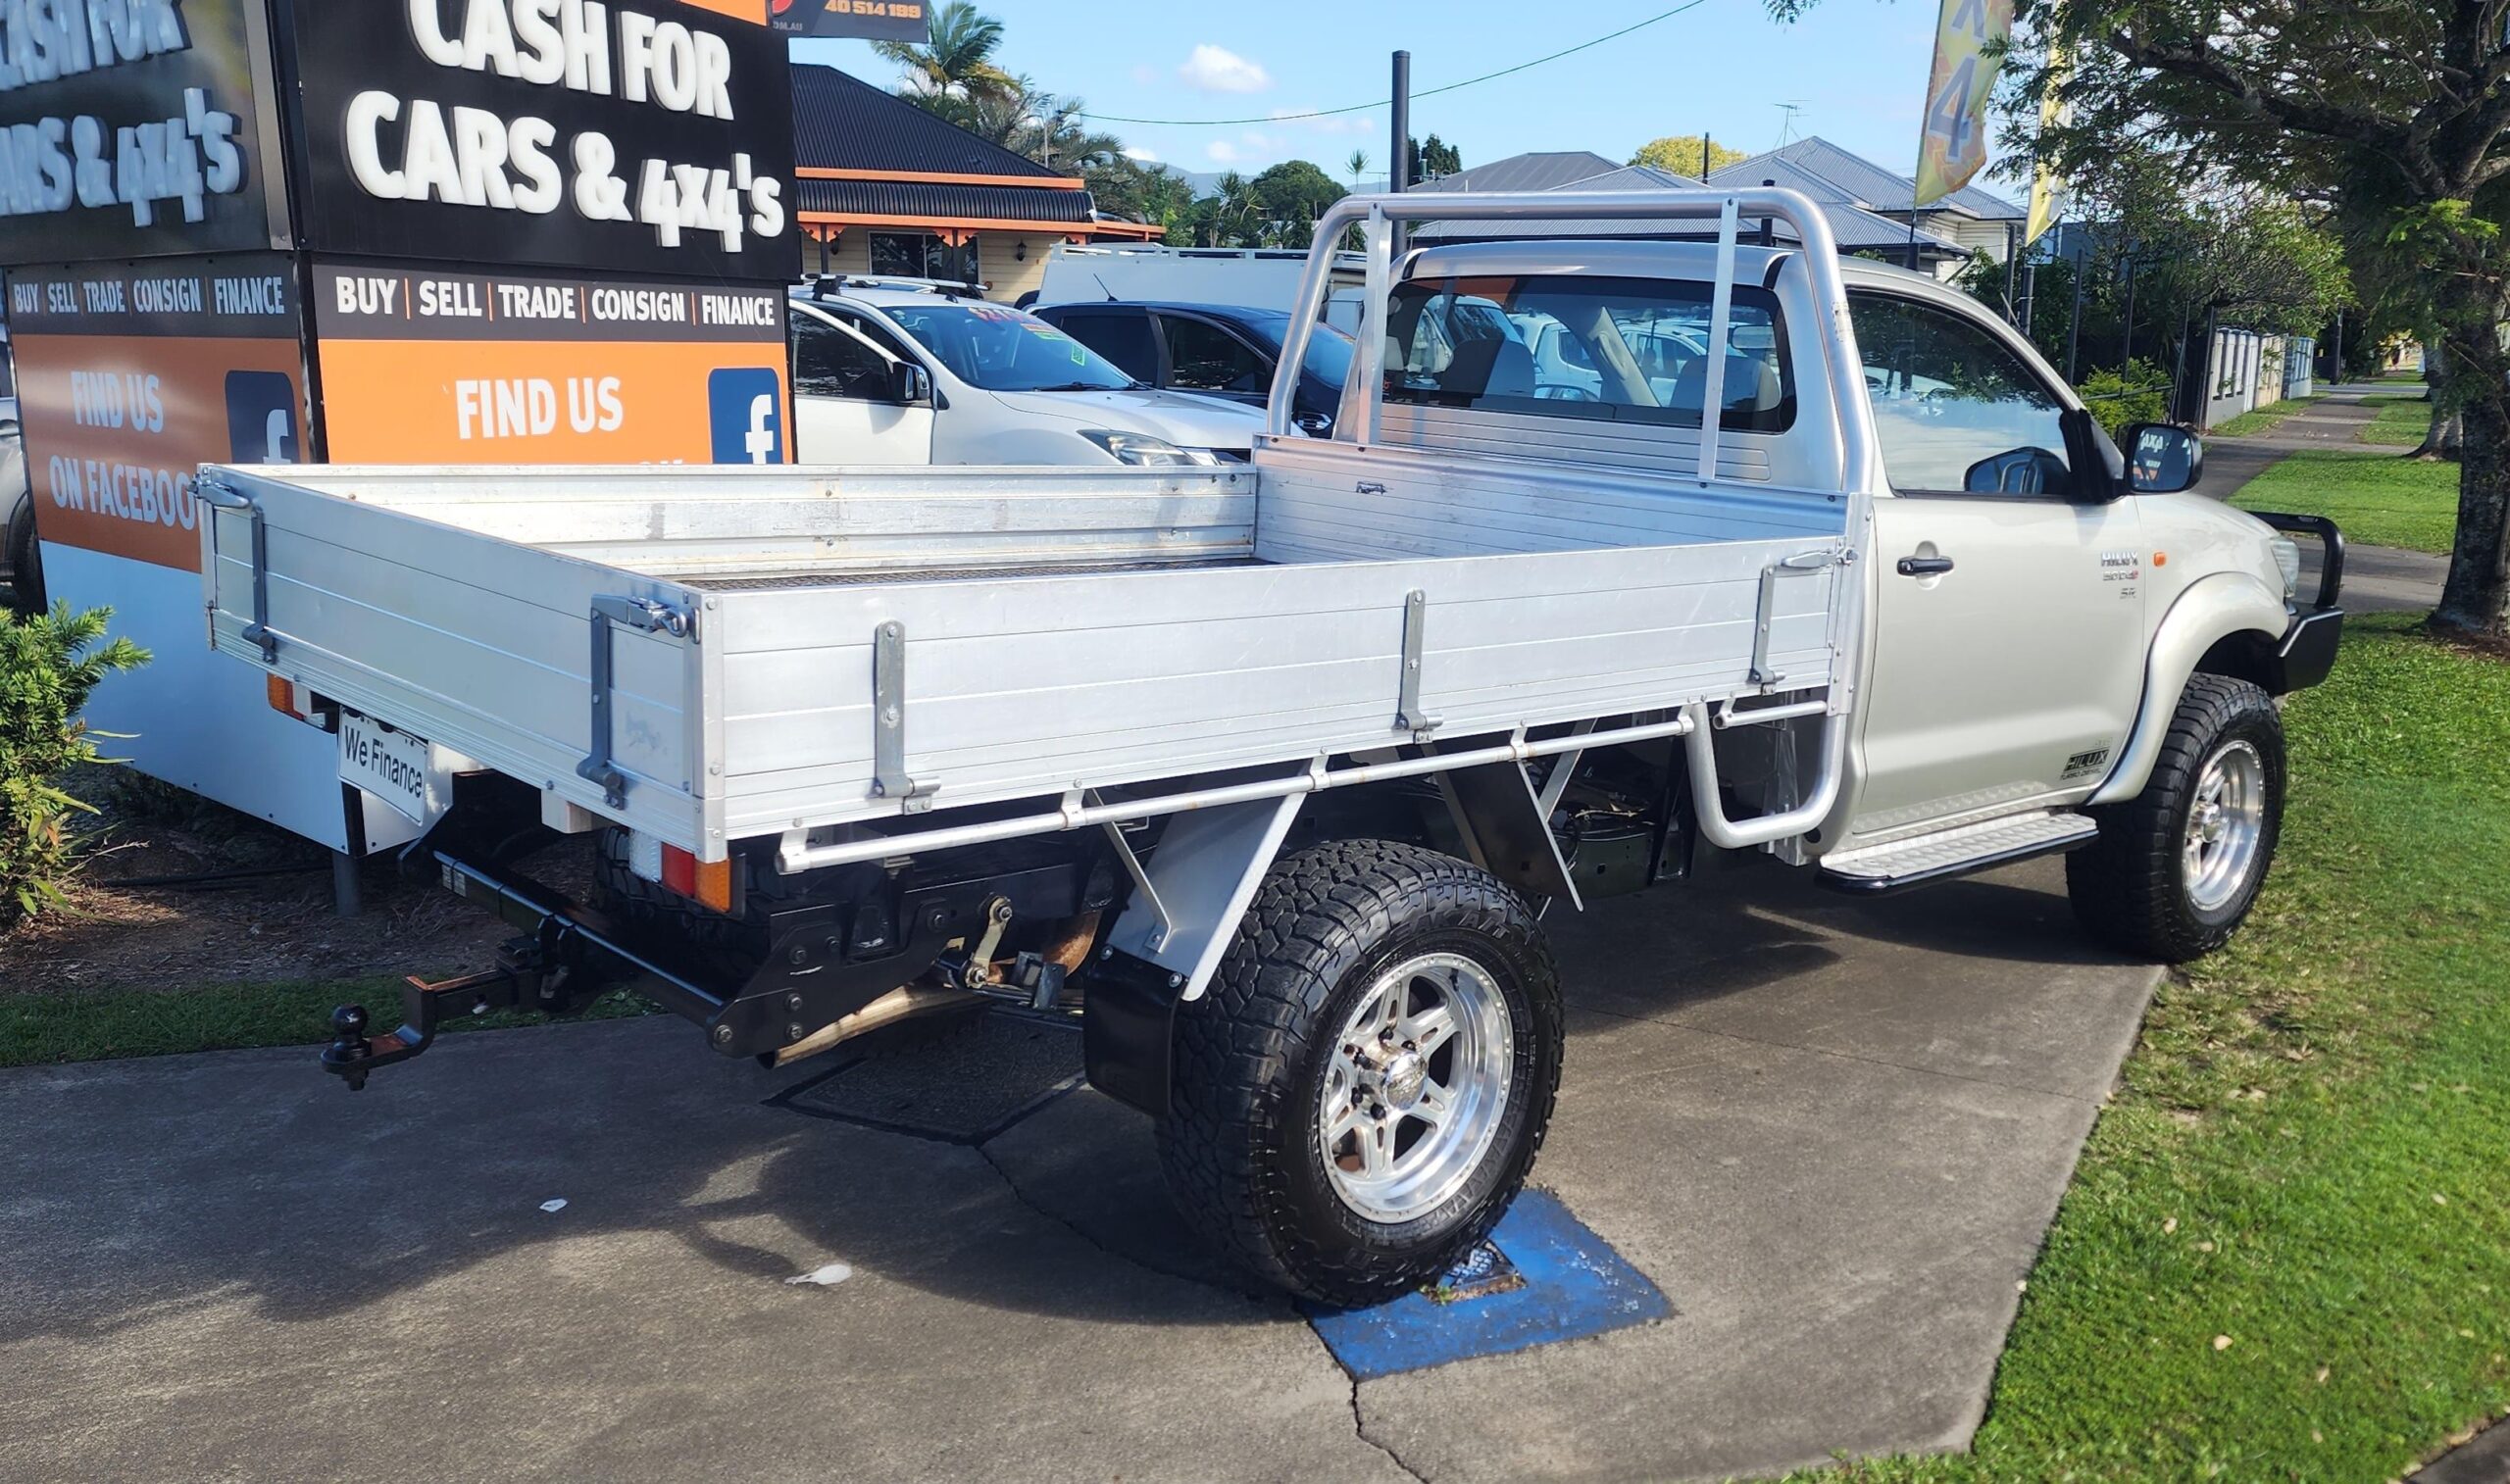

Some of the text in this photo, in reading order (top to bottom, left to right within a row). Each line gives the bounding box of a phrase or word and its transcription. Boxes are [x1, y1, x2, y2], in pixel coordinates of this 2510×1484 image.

[852, 1, 885, 16] 514
[887, 4, 923, 19] 199
[409, 0, 734, 121] CASH FOR
[72, 115, 117, 208] &
[346, 90, 562, 214] CARS
[574, 131, 633, 221] &
[14, 276, 285, 315] BUY SELL TRADE CONSIGN FINANCE
[335, 276, 776, 326] BUY SELL TRADE CONSIGN FINANCE
[70, 371, 164, 434] FIND US
[456, 376, 625, 440] FIND US
[50, 454, 196, 531] ON FACEBOO
[344, 725, 423, 799] We Finance
[2065, 748, 2109, 771] HILUX
